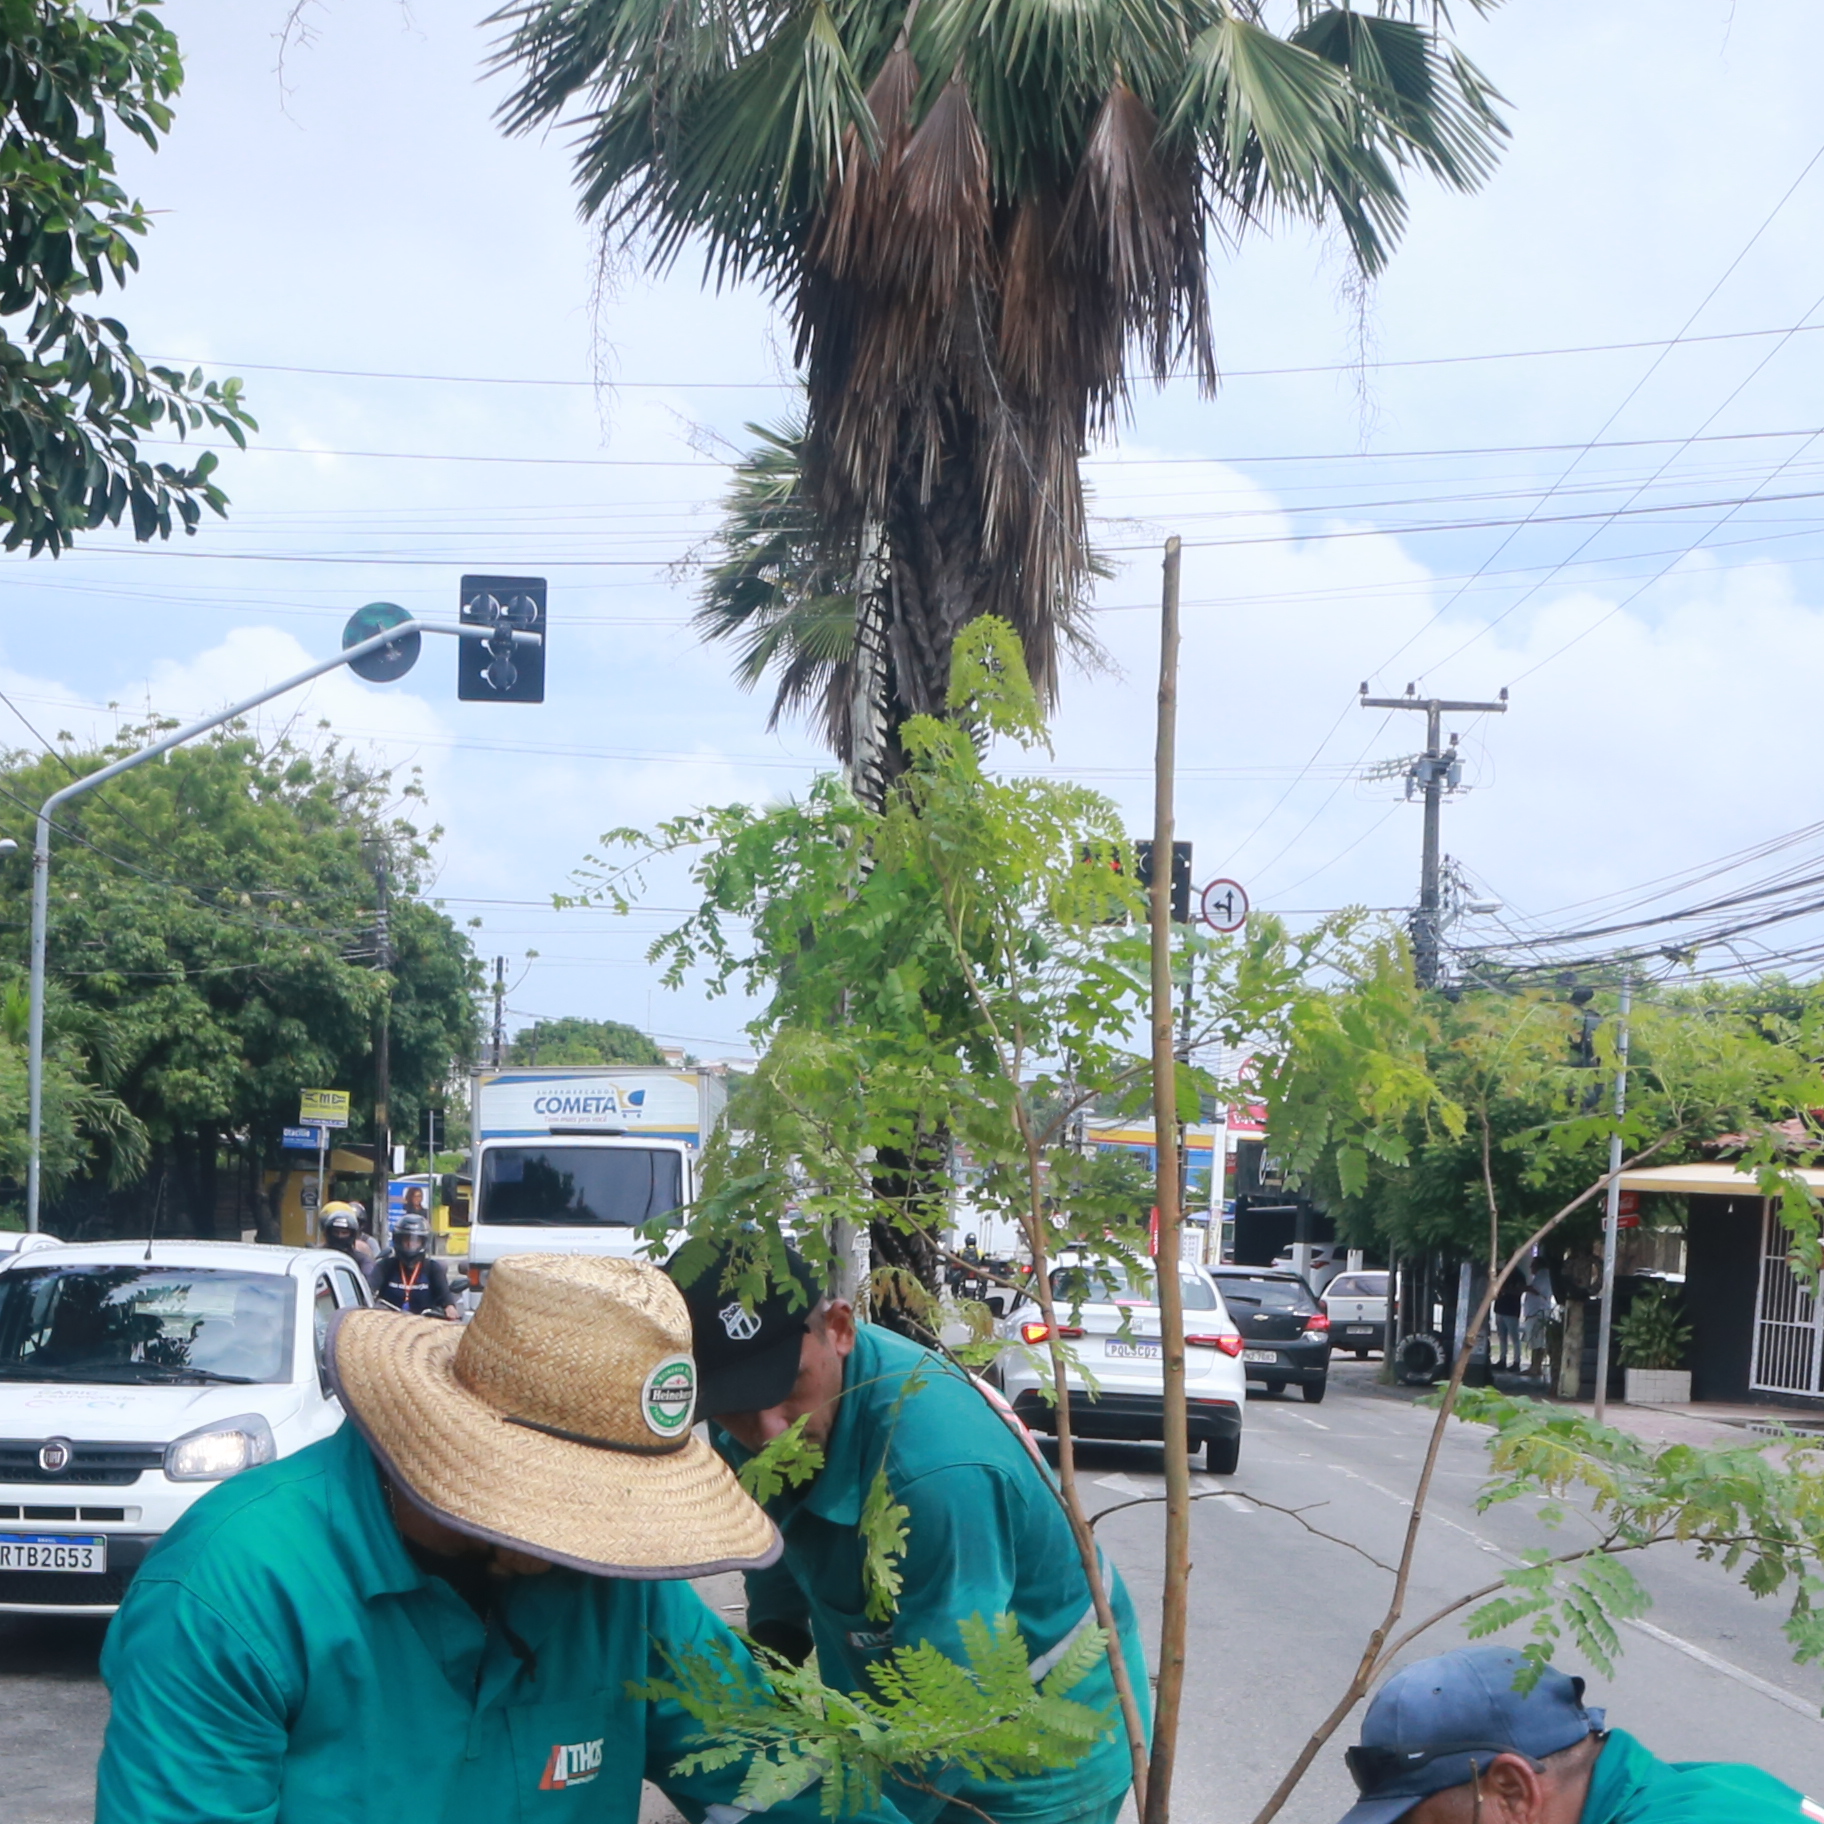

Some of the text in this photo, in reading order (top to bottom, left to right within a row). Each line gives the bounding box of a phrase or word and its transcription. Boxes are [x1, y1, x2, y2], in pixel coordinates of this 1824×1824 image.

[533, 1096, 618, 1114] COMETA
[652, 1389, 692, 1401] Heineken
[0, 1545, 93, 1568] RTB2G53
